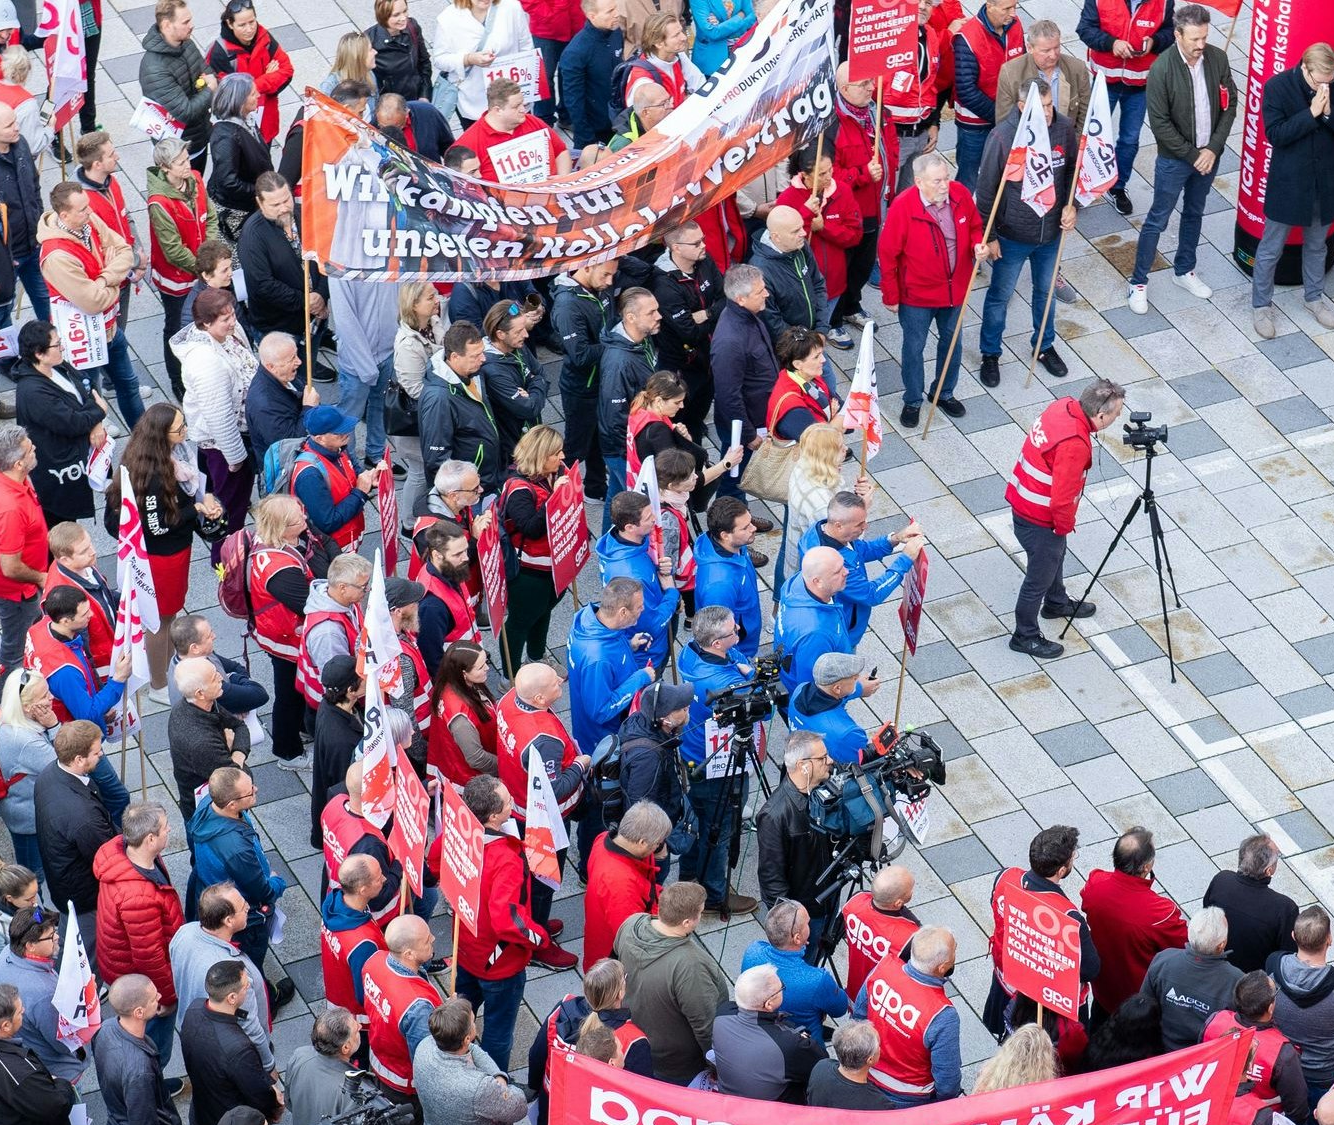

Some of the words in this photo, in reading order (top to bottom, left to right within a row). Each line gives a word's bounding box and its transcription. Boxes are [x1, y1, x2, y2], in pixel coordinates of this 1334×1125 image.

[854, 8, 898, 24] KÄMPFEN
[854, 23, 873, 34] FÜR
[874, 14, 916, 31] UNSEREN
[855, 5, 874, 15] WIR
[854, 28, 907, 44] KOLLEKTIV-
[854, 38, 897, 53] VERTRAG!
[1251, 7, 1269, 76] MICH
[887, 51, 916, 69] gpa
[1245, 76, 1263, 149] MACH
[497, 149, 543, 174] 11,6%
[1241, 154, 1255, 196] ICH
[398, 174, 559, 237] kämpfen
[556, 181, 625, 221] für
[361, 226, 523, 261] unseren
[68, 312, 88, 368] 11,6%
[145, 495, 157, 511] SEA
[1008, 903, 1027, 922] WIR
[847, 913, 891, 957] gpa
[1008, 916, 1055, 946] KÄMPFEN
[1008, 927, 1028, 945] FÜR
[1028, 937, 1075, 968] UNSEREN
[1008, 938, 1063, 972] KOLLEKTIV-
[1007, 948, 1054, 979] VERTRAG!
[870, 978, 921, 1030] gpa
[1042, 986, 1072, 1010] gpa
